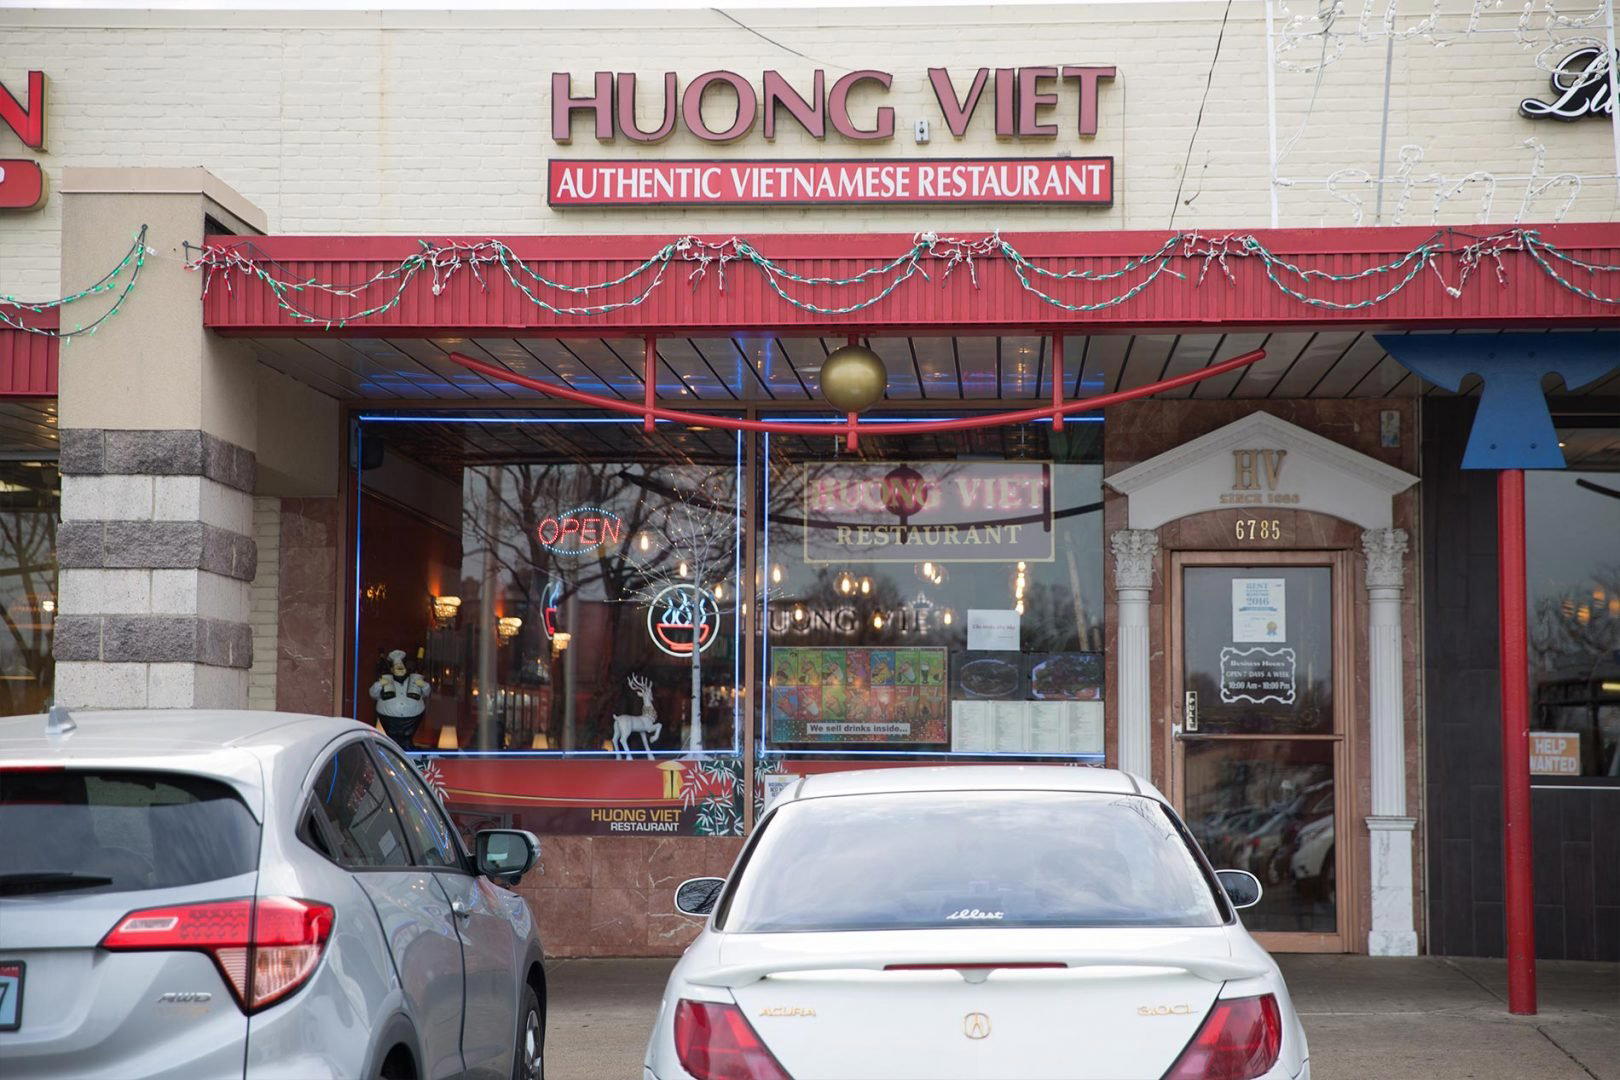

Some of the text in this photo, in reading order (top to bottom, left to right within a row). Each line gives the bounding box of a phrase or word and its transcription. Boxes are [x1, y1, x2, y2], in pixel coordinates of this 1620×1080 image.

[551, 65, 1117, 144] HUONG VIET
[556, 164, 1107, 199] AUTHENTIC VIETNAMESE RESTAURANT
[1232, 449, 1287, 491] HV
[809, 476, 1045, 511] HUONG VIET
[538, 517, 623, 545] OPEN
[836, 525, 1023, 546] RESTAURANT
[1235, 519, 1281, 540] 6785
[810, 724, 823, 732] We
[826, 724, 841, 732] sell
[844, 724, 871, 732] drinks
[1535, 738, 1567, 754] HELP
[591, 809, 682, 822] HUONG VIET
[610, 822, 679, 832] RESTAURANT
[758, 1007, 816, 1017] ACURA
